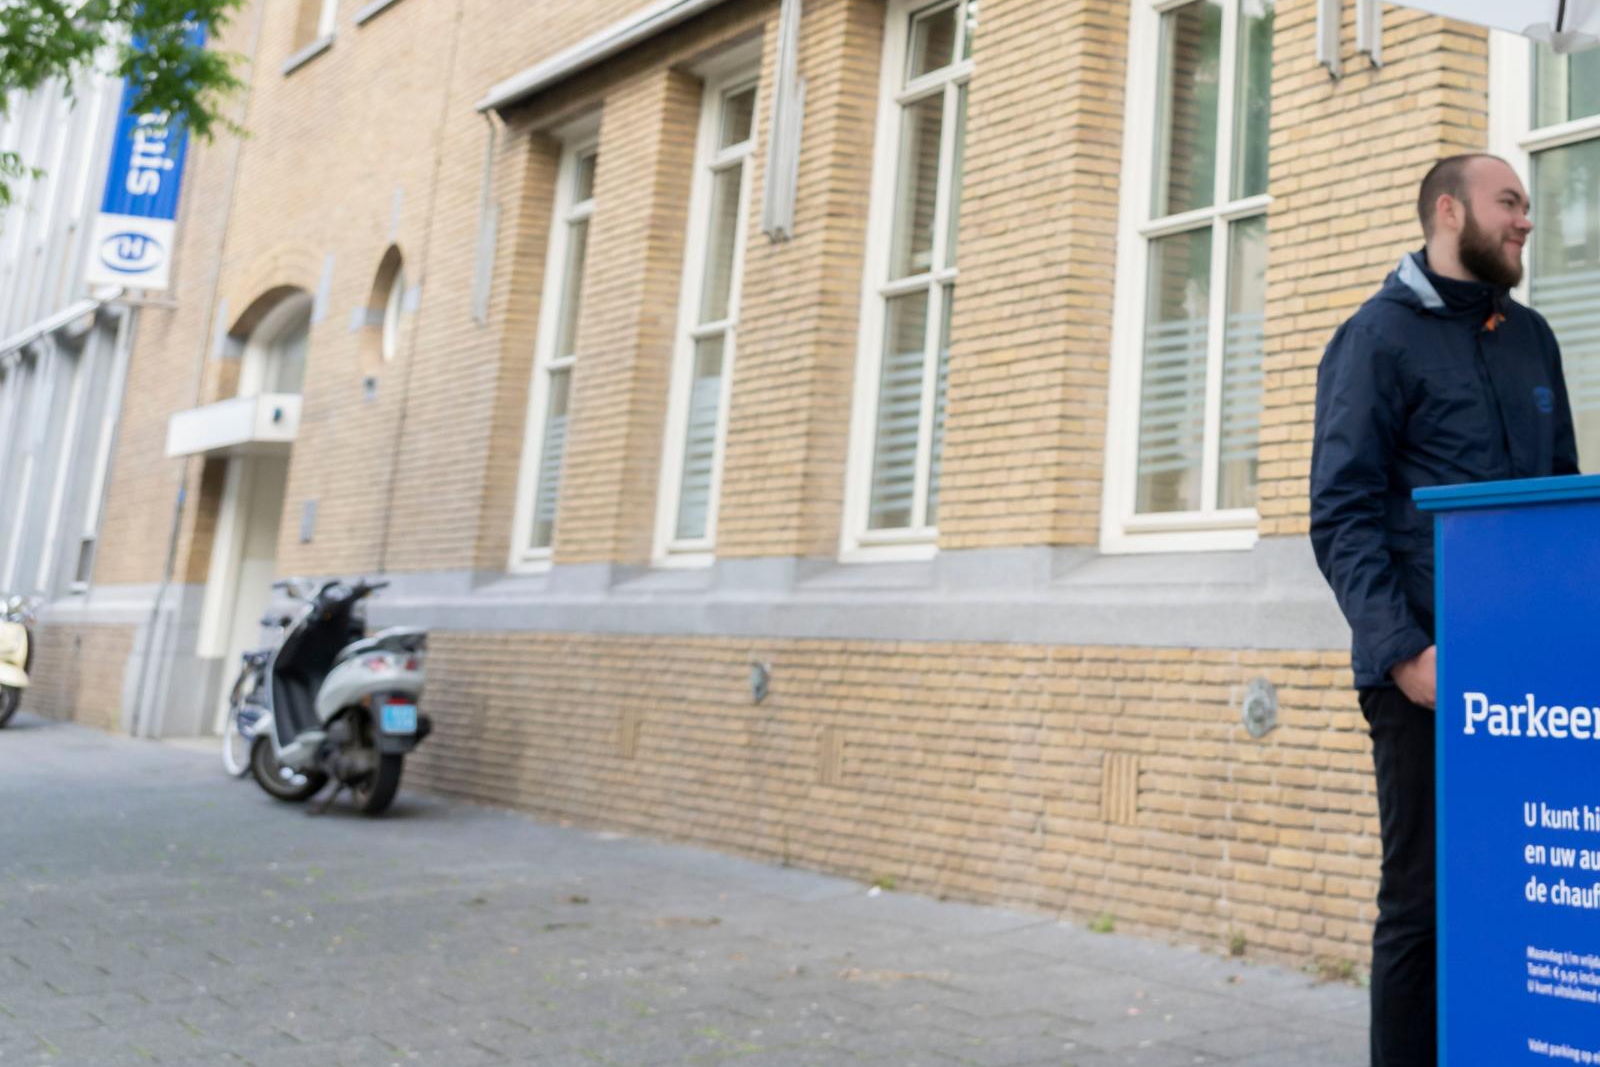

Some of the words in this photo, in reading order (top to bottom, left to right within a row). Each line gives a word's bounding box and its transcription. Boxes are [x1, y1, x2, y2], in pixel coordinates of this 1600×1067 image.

[1524, 802, 1537, 826] U
[1541, 802, 1580, 831] kunt
[1524, 845, 1546, 864] en
[1550, 847, 1575, 867] uw
[1525, 875, 1547, 903] de
[1527, 946, 1563, 965] Maandag
[1553, 966, 1559, 980] €
[1527, 979, 1534, 993] U
[1535, 980, 1552, 996] kunt
[1554, 984, 1597, 1003] uitsluitend
[1549, 1043, 1580, 1063] parking
[1581, 1051, 1592, 1065] op
